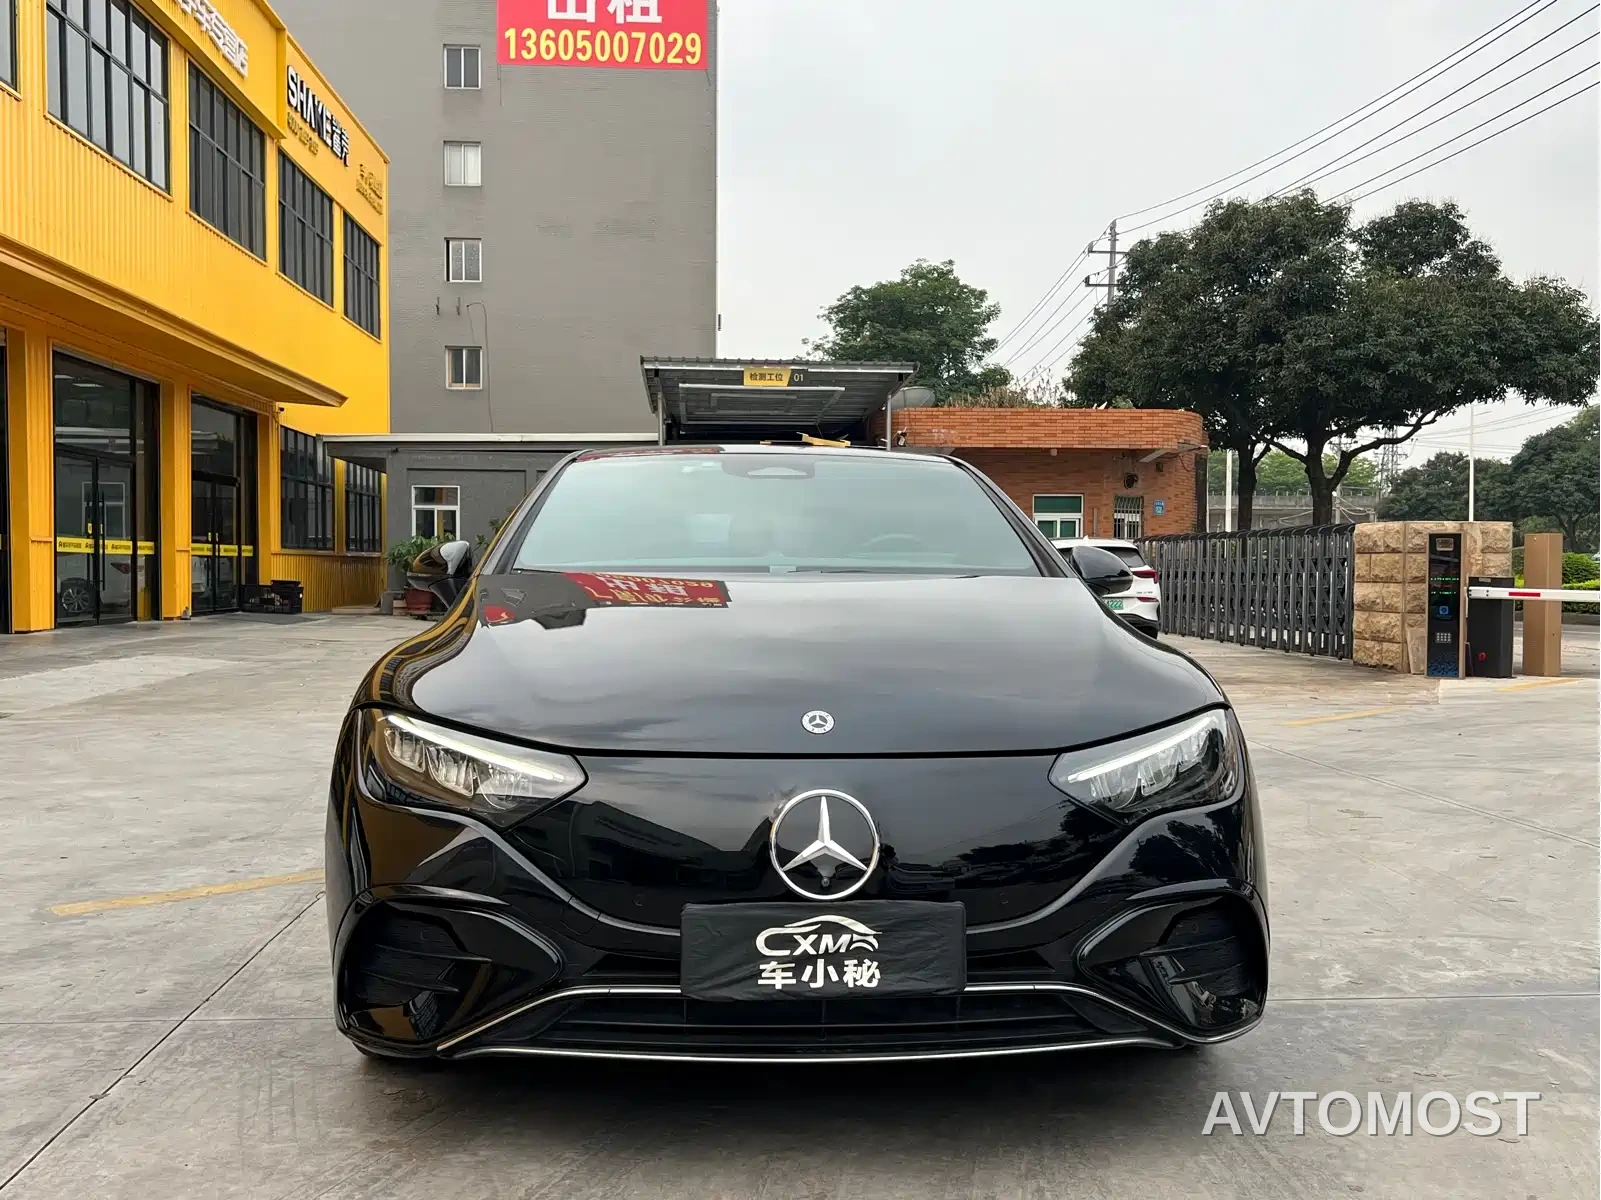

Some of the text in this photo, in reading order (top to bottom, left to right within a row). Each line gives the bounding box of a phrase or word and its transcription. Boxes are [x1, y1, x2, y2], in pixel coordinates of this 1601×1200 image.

[504, 28, 701, 65] 13605007029
[287, 65, 332, 148] SHAKE
[750, 372, 804, 382] 检测工位 01
[758, 959, 881, 990] 车小秘
